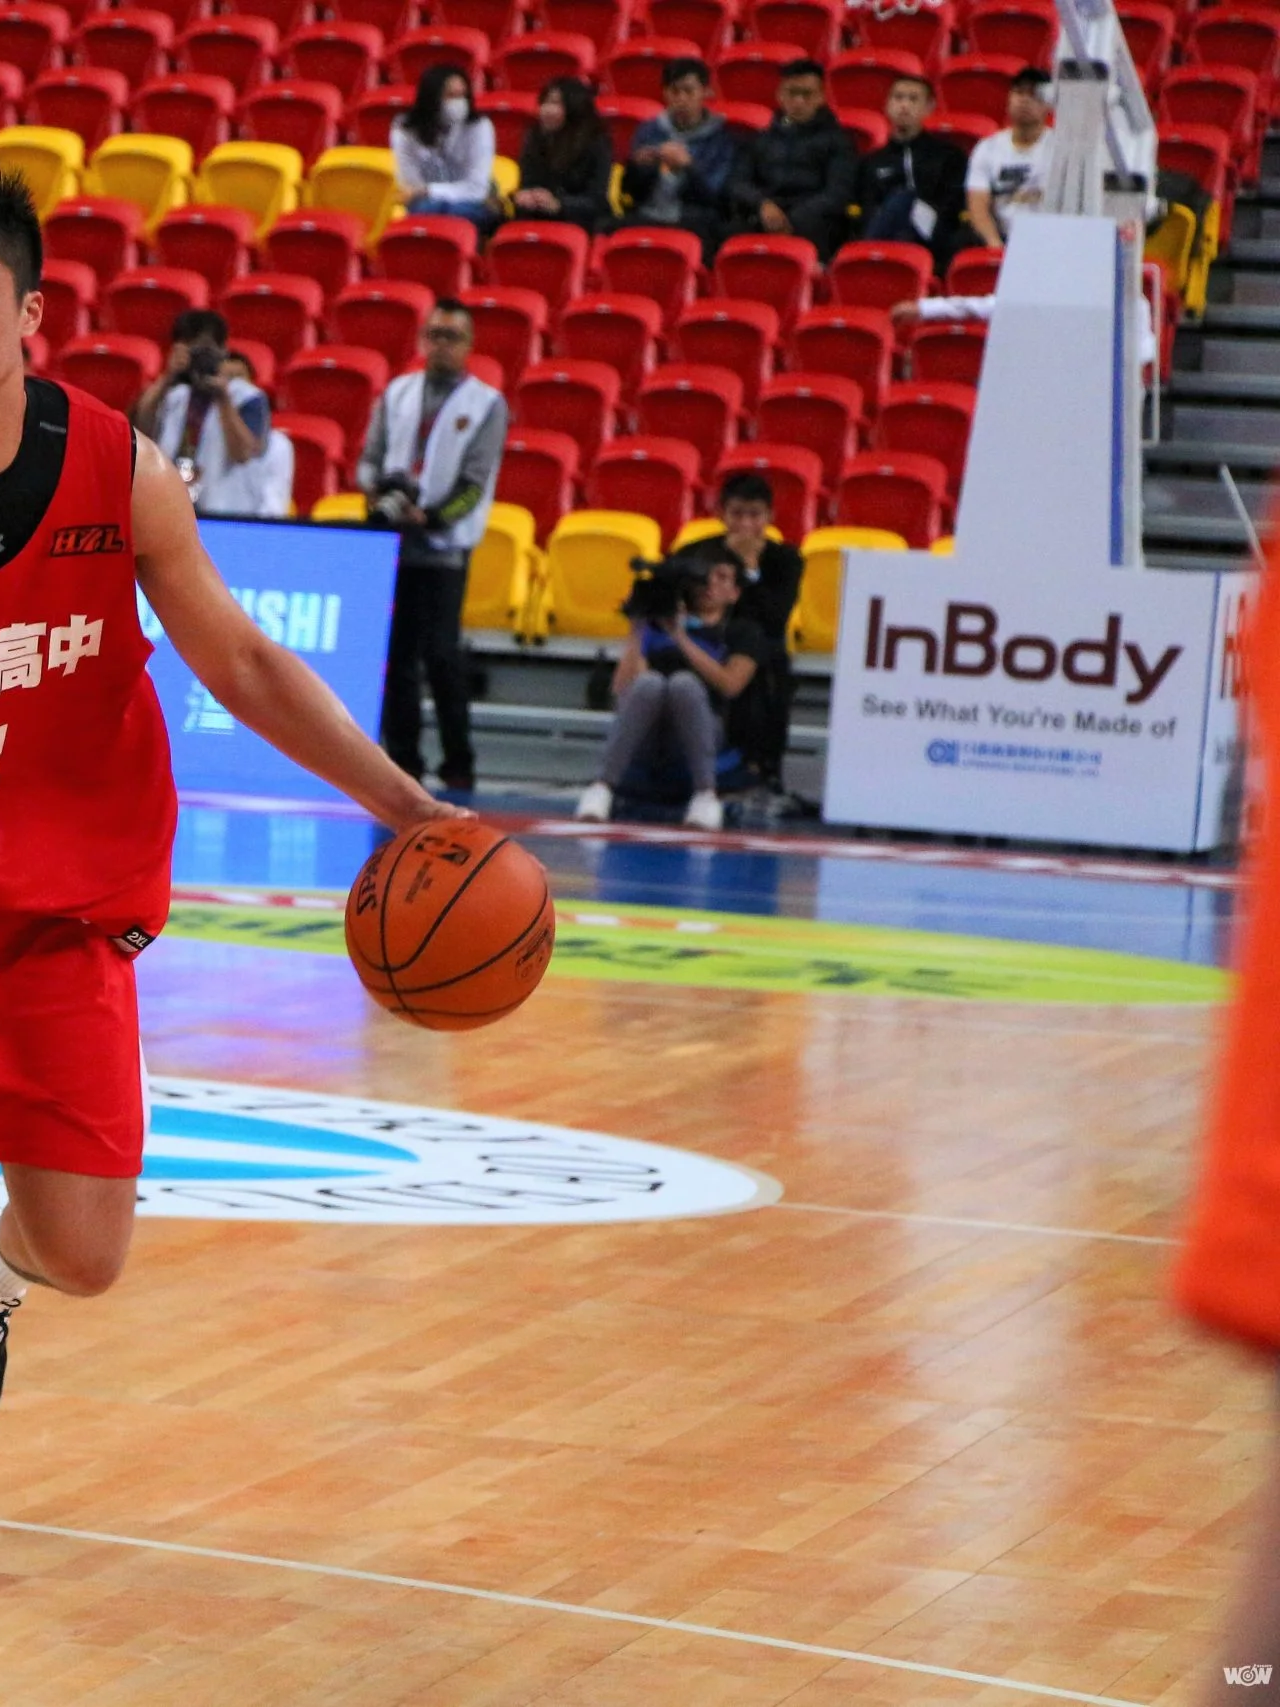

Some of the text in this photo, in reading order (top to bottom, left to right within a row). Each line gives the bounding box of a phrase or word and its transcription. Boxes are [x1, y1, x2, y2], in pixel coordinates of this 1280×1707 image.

[864, 596, 1184, 706] InBody
[861, 694, 1177, 739] See What You're Made of
[126, 931, 148, 948] 2XL
